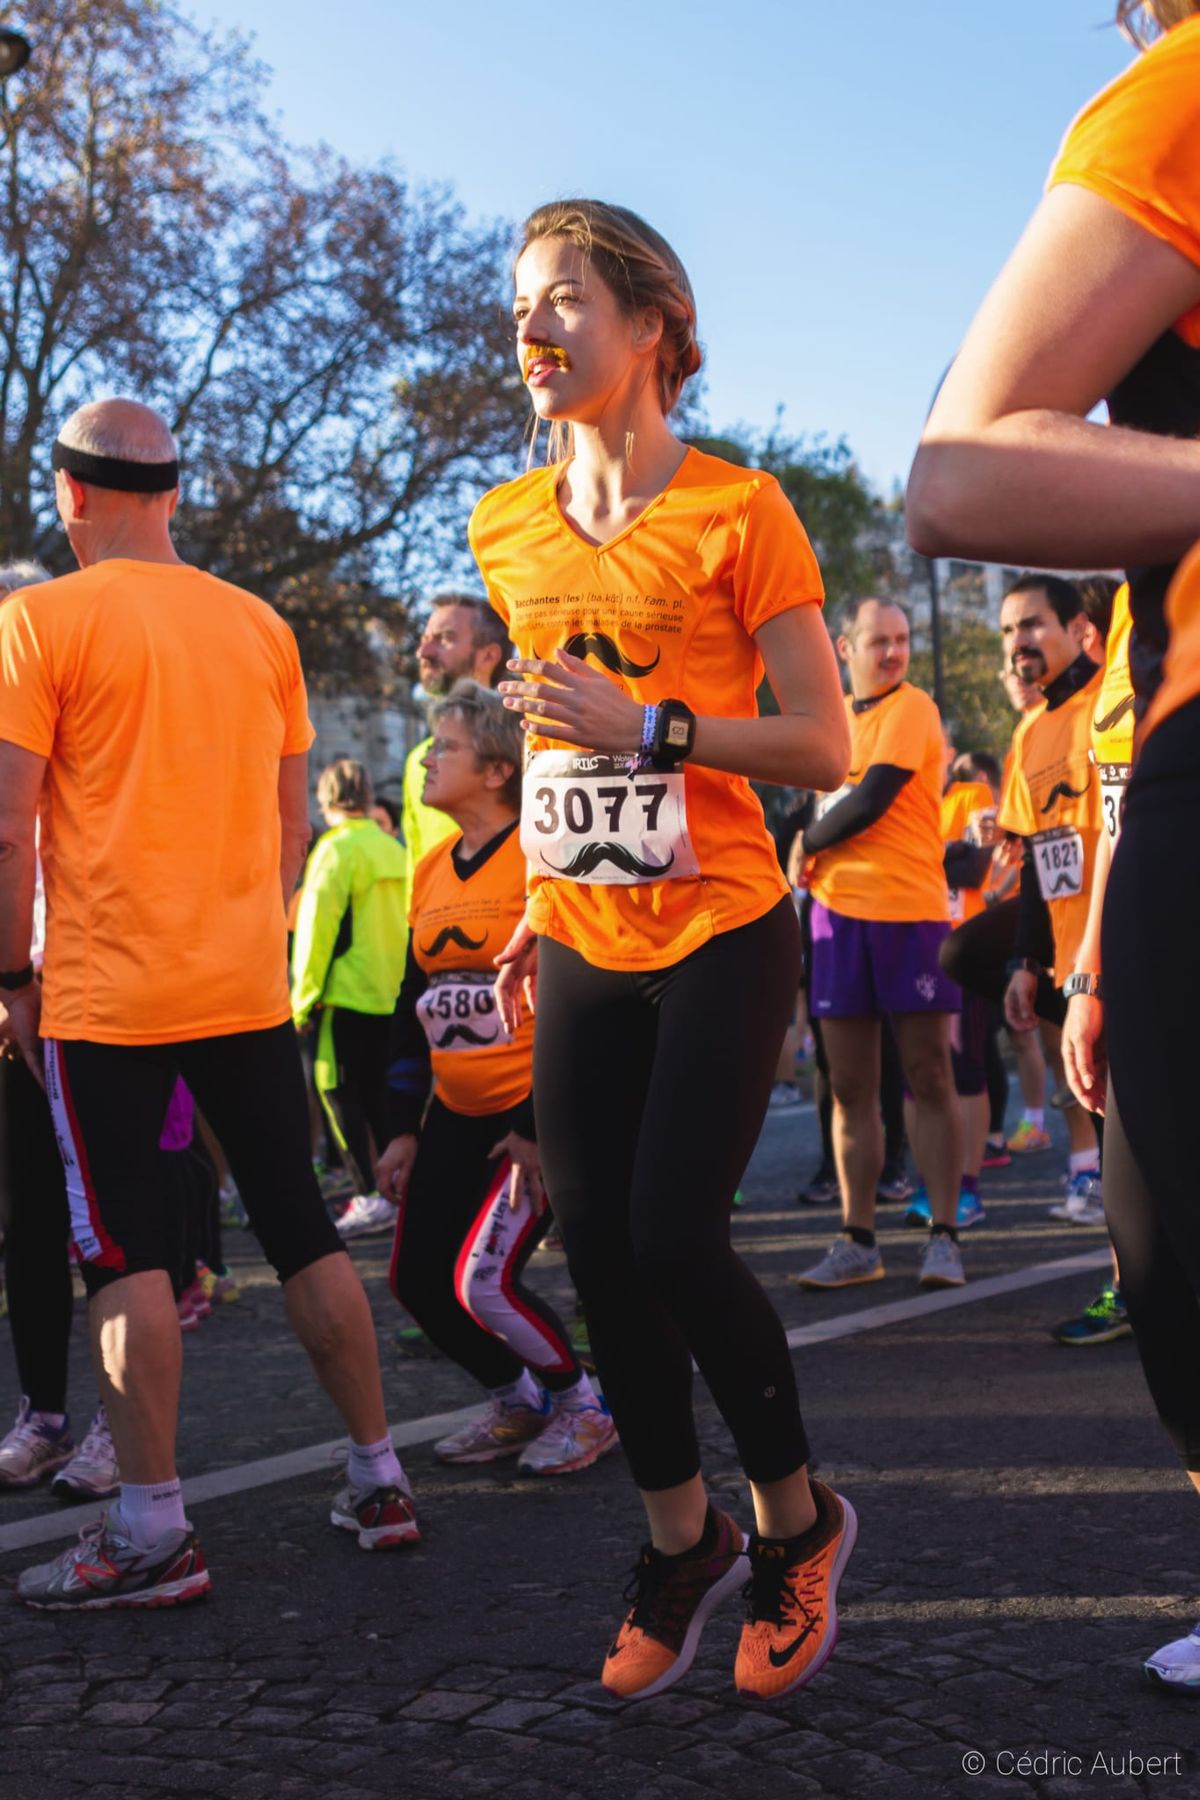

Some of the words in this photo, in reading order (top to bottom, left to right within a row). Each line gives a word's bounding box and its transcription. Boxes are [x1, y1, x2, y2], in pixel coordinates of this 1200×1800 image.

[645, 595, 669, 607] Fam.
[673, 599, 685, 610] pl.
[645, 621, 682, 633] prostate
[534, 783, 668, 834] 3077
